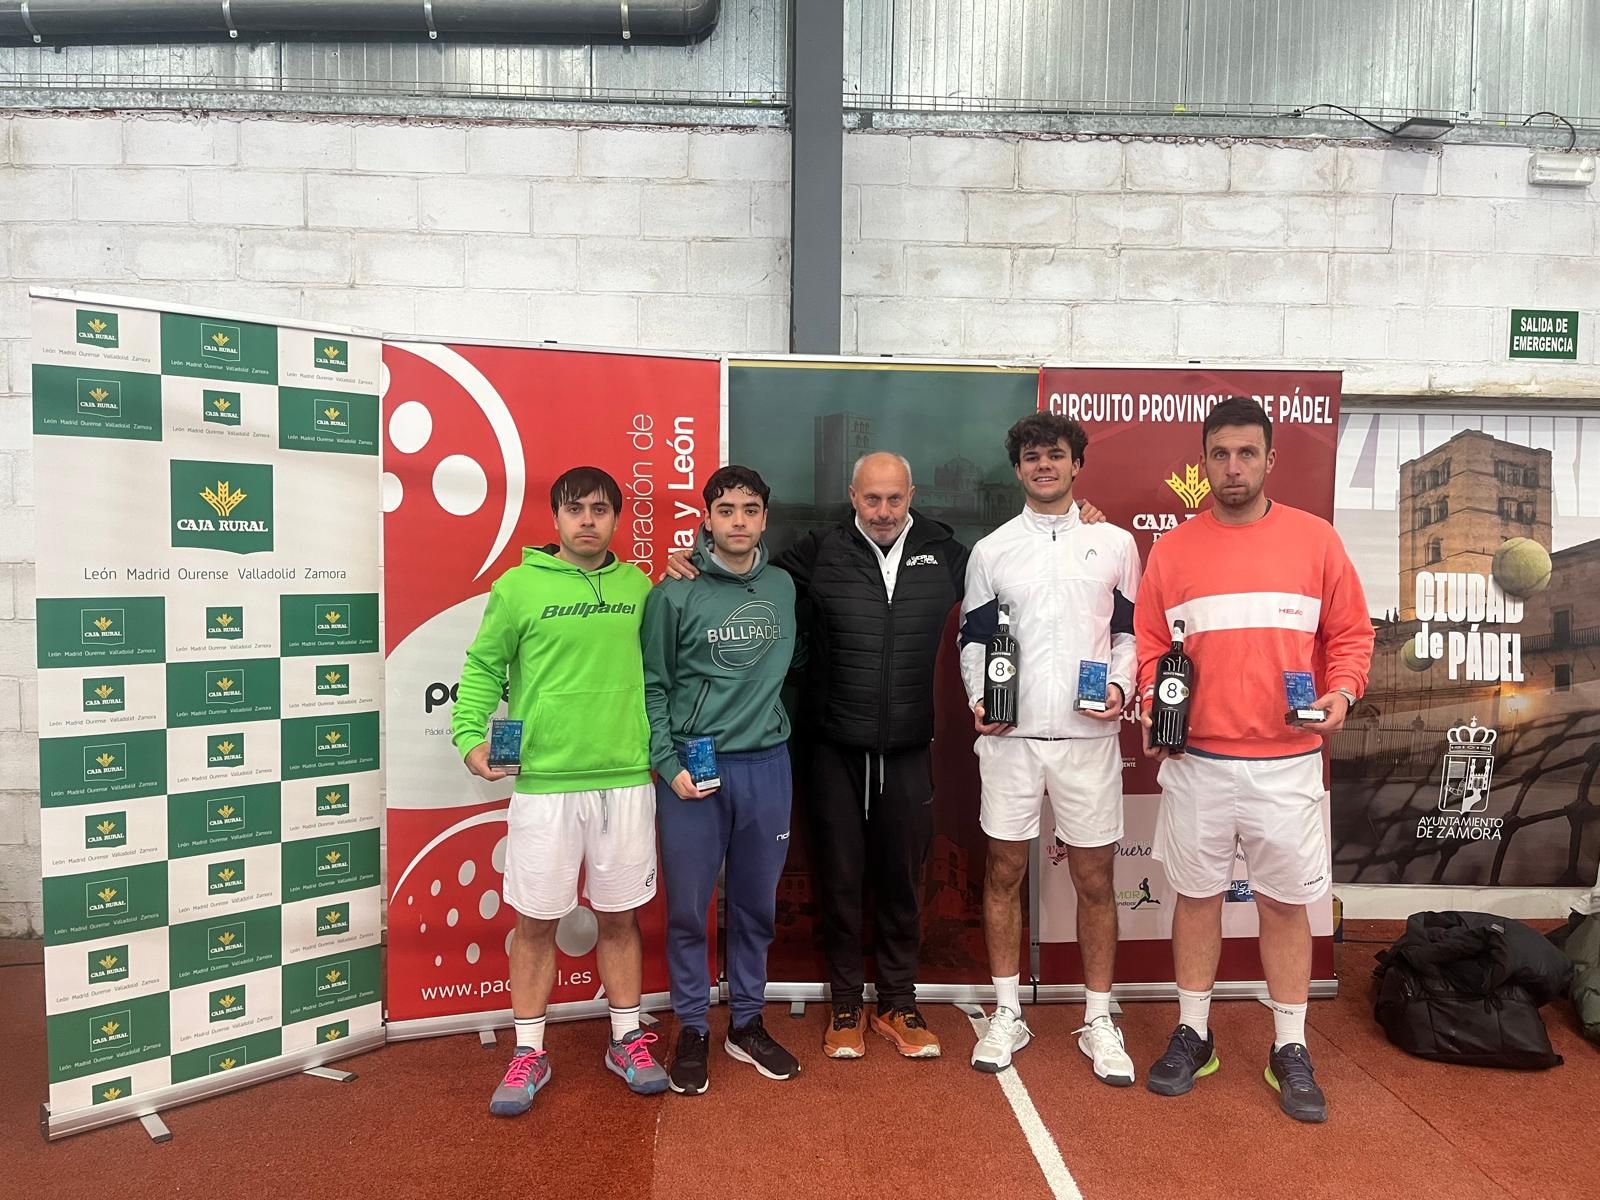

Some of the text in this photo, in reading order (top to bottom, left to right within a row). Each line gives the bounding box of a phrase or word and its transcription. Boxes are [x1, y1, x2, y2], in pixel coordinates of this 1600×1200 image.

[1520, 317, 1568, 333] SALIDA DE
[1513, 336, 1573, 352] EMERGENCIA
[1050, 393, 1134, 422] CIRCUITO
[1280, 387, 1332, 423] PÁDEL
[666, 417, 694, 490] León
[626, 414, 653, 577] deración de
[674, 501, 701, 519] y
[177, 519, 268, 532] CAJA RURAL
[1132, 514, 1178, 531] CAJA
[84, 567, 346, 580] León Madrid Ourense Valladolid Zamora
[541, 602, 636, 619] Bullpadel
[1415, 622, 1524, 681] de PÁDEL
[995, 661, 1005, 676] 8
[1167, 683, 1177, 698] 8
[1418, 816, 1503, 828] AYUNTAMIENTO
[1416, 826, 1501, 840] DE ZAMORA
